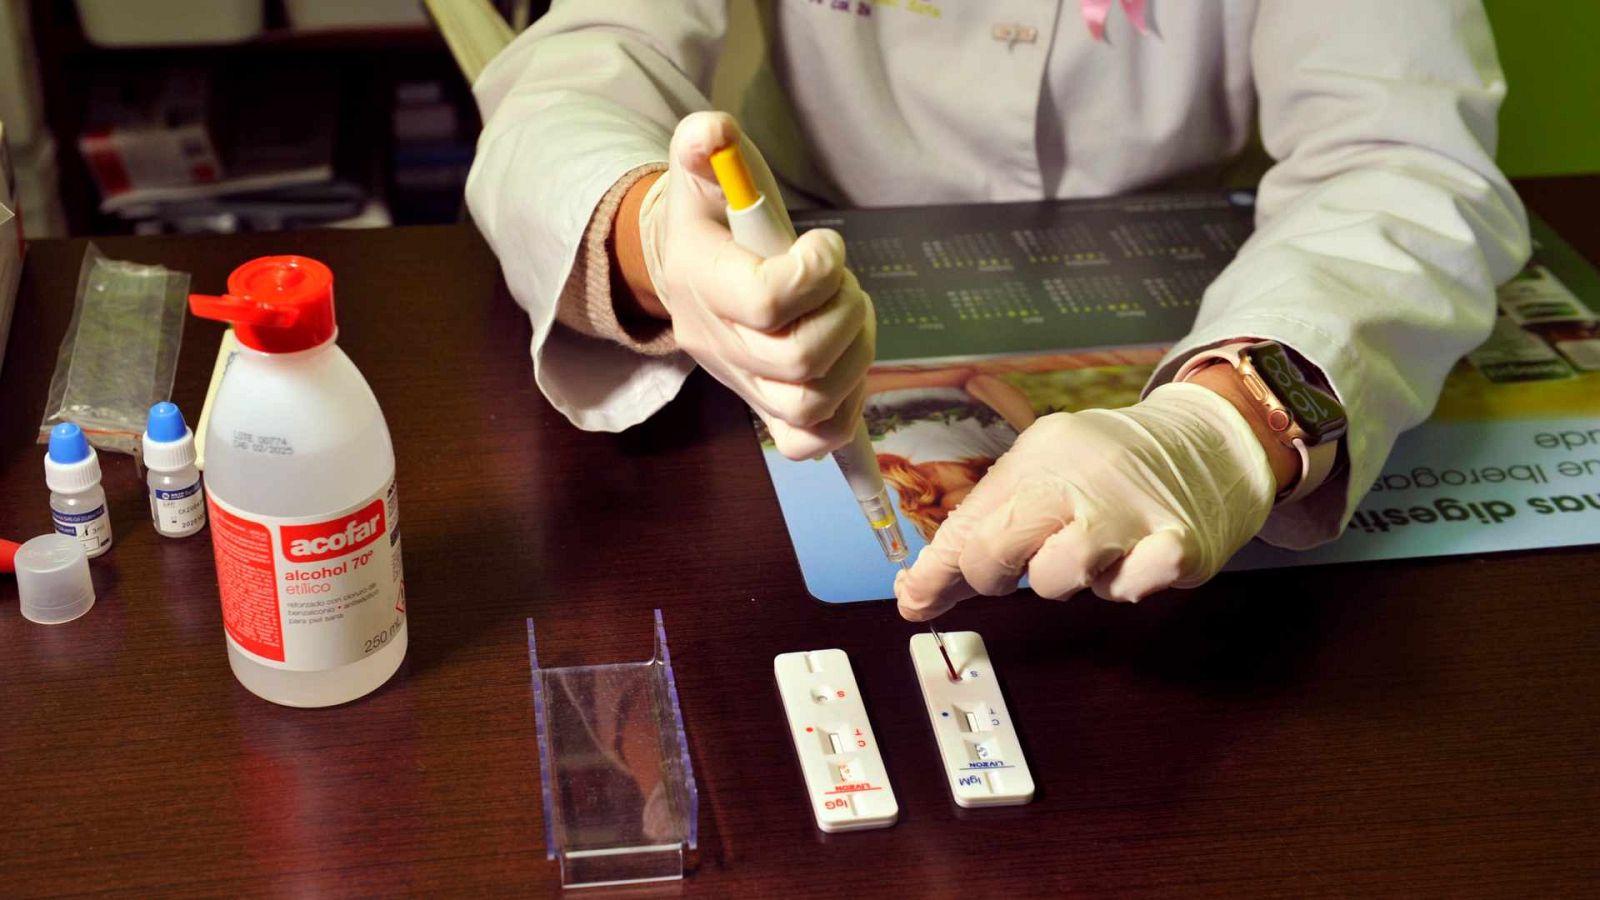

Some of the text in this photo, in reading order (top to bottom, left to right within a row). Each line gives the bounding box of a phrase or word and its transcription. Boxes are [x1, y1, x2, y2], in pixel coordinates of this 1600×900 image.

[290, 513, 380, 557] acofar
[285, 562, 347, 581] alcohol
[364, 630, 388, 653] 250
[970, 670, 978, 678] S
[836, 690, 845, 698] S
[991, 718, 1000, 727] C
[854, 728, 863, 737] T
[857, 740, 866, 748] C
[968, 760, 1004, 769] LIVZON
[959, 775, 982, 787] IgM
[835, 783, 871, 793] LIVZON
[824, 798, 849, 810] IgG
